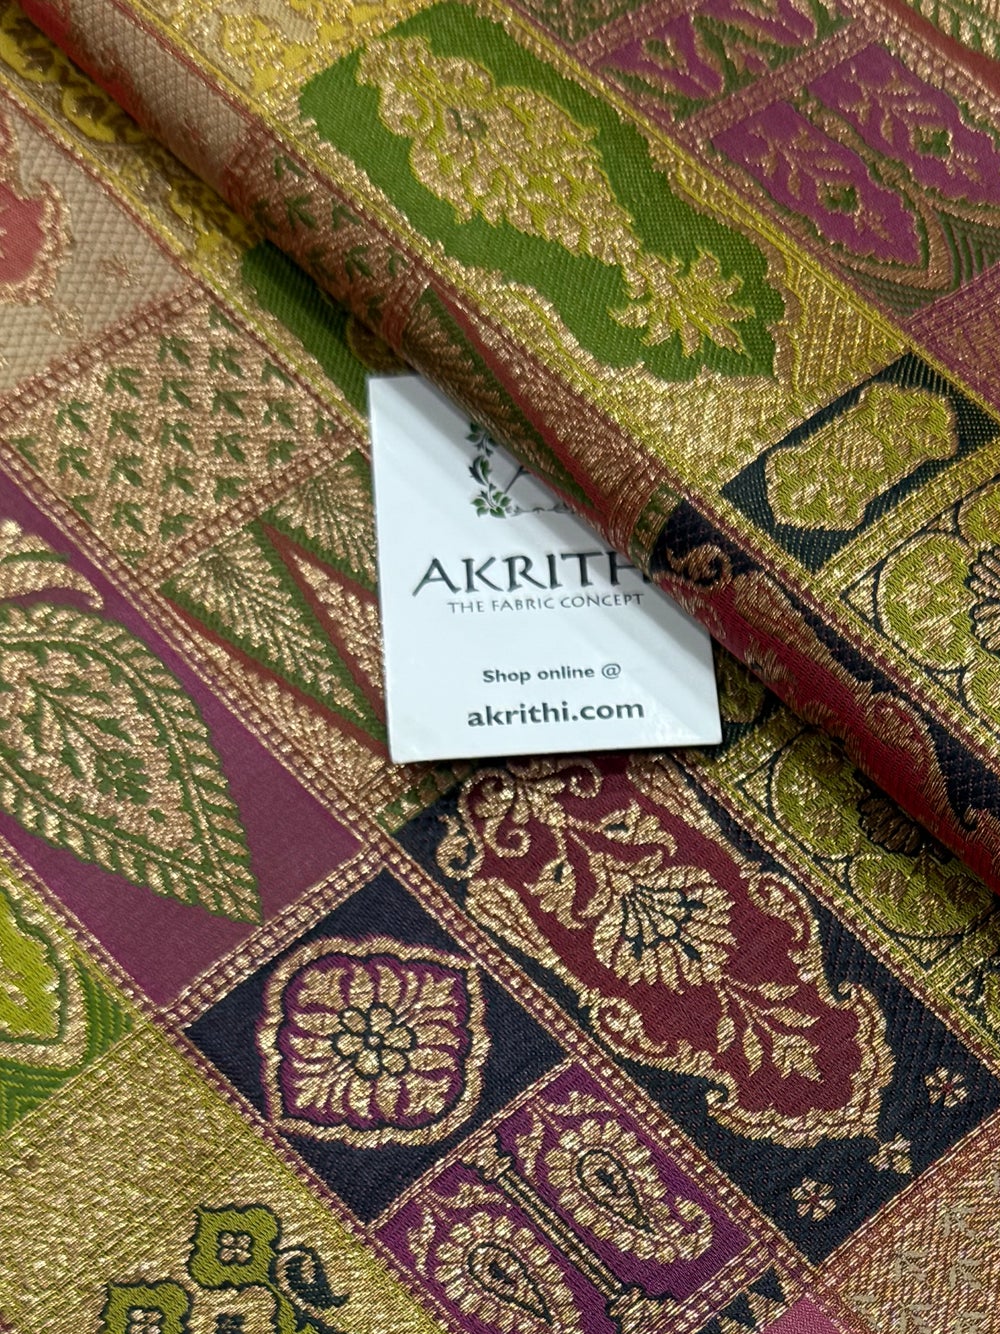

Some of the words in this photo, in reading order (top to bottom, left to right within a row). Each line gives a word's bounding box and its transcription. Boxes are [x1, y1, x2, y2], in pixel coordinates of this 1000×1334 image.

[411, 550, 652, 597] AKRITH
[448, 601, 485, 614] THE
[491, 597, 555, 612] FABRIC
[560, 593, 645, 609] CONCEPT
[482, 669, 532, 685] Shop
[537, 665, 595, 680] online
[601, 662, 622, 679] @
[467, 700, 645, 728] akrithi.com
